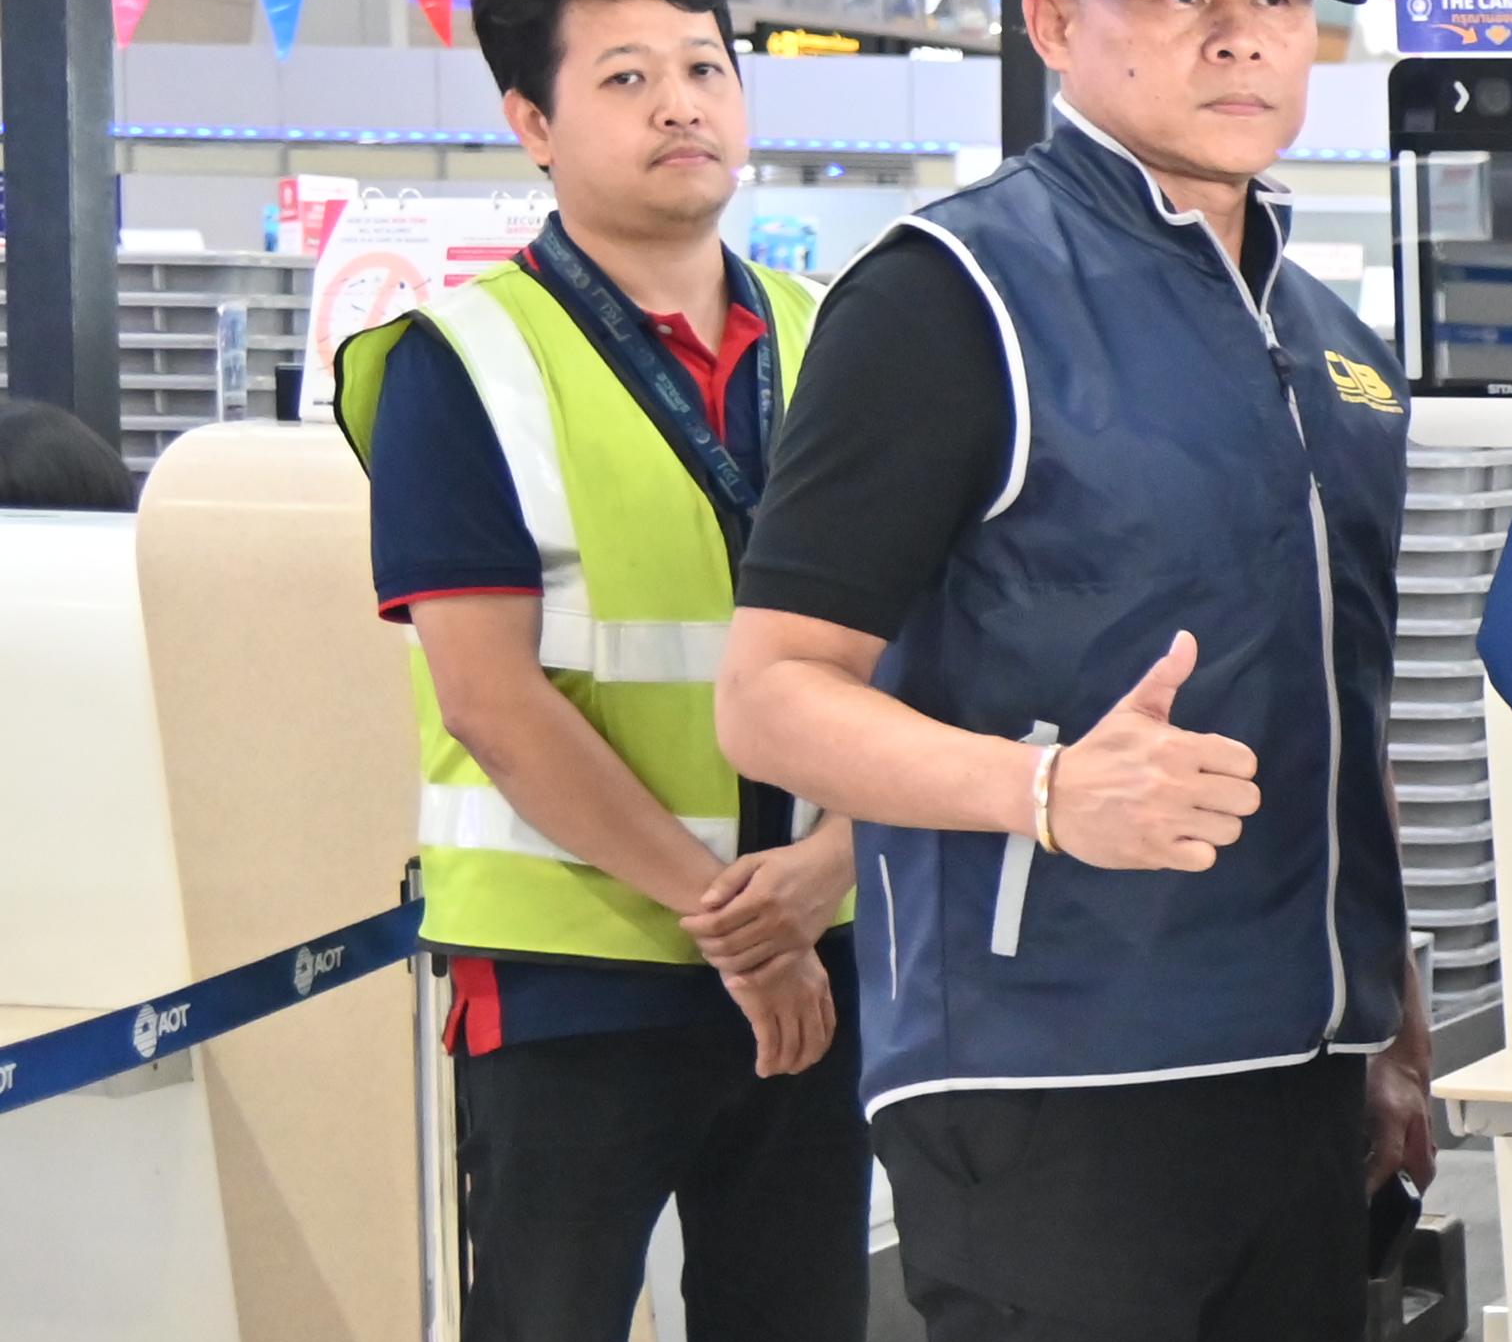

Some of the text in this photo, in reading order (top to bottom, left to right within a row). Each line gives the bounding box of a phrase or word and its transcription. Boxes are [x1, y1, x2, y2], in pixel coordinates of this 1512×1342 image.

[1324, 350, 1393, 399] CIB
[314, 945, 345, 976] AOT
[158, 1002, 191, 1038] AOT
